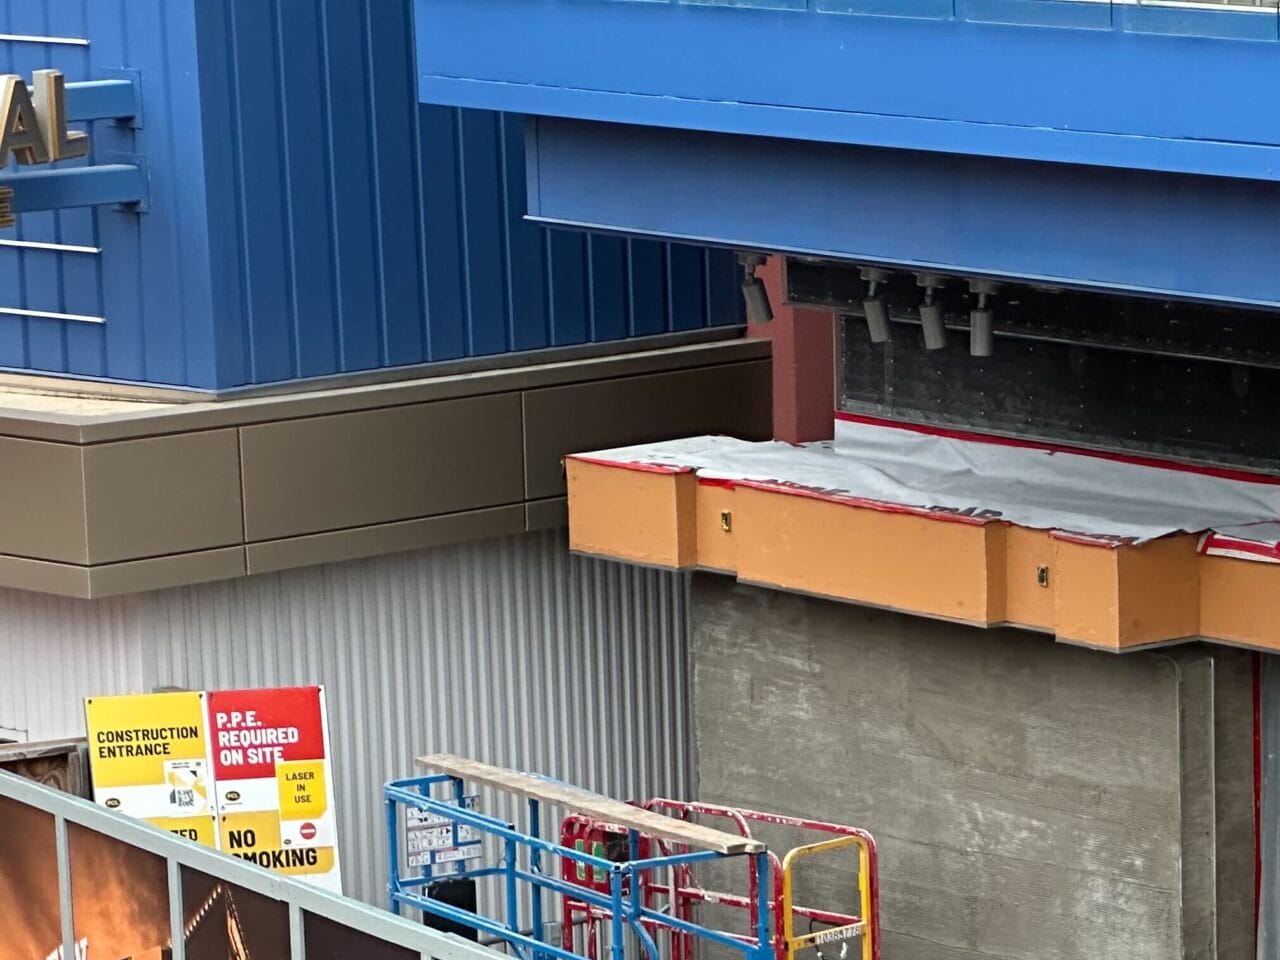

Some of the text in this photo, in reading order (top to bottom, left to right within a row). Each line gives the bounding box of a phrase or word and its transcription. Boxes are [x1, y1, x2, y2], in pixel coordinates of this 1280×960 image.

[216, 711, 262, 728] P.P.E.
[97, 726, 199, 743] CONSTRUCTION
[219, 727, 299, 747] REQUIRED
[99, 742, 171, 759] ENTRANCE
[220, 746, 285, 766] ON SITE
[286, 772, 315, 781] LASER
[297, 784, 306, 792] IN
[294, 795, 312, 804] USE
[229, 830, 256, 848] NO
